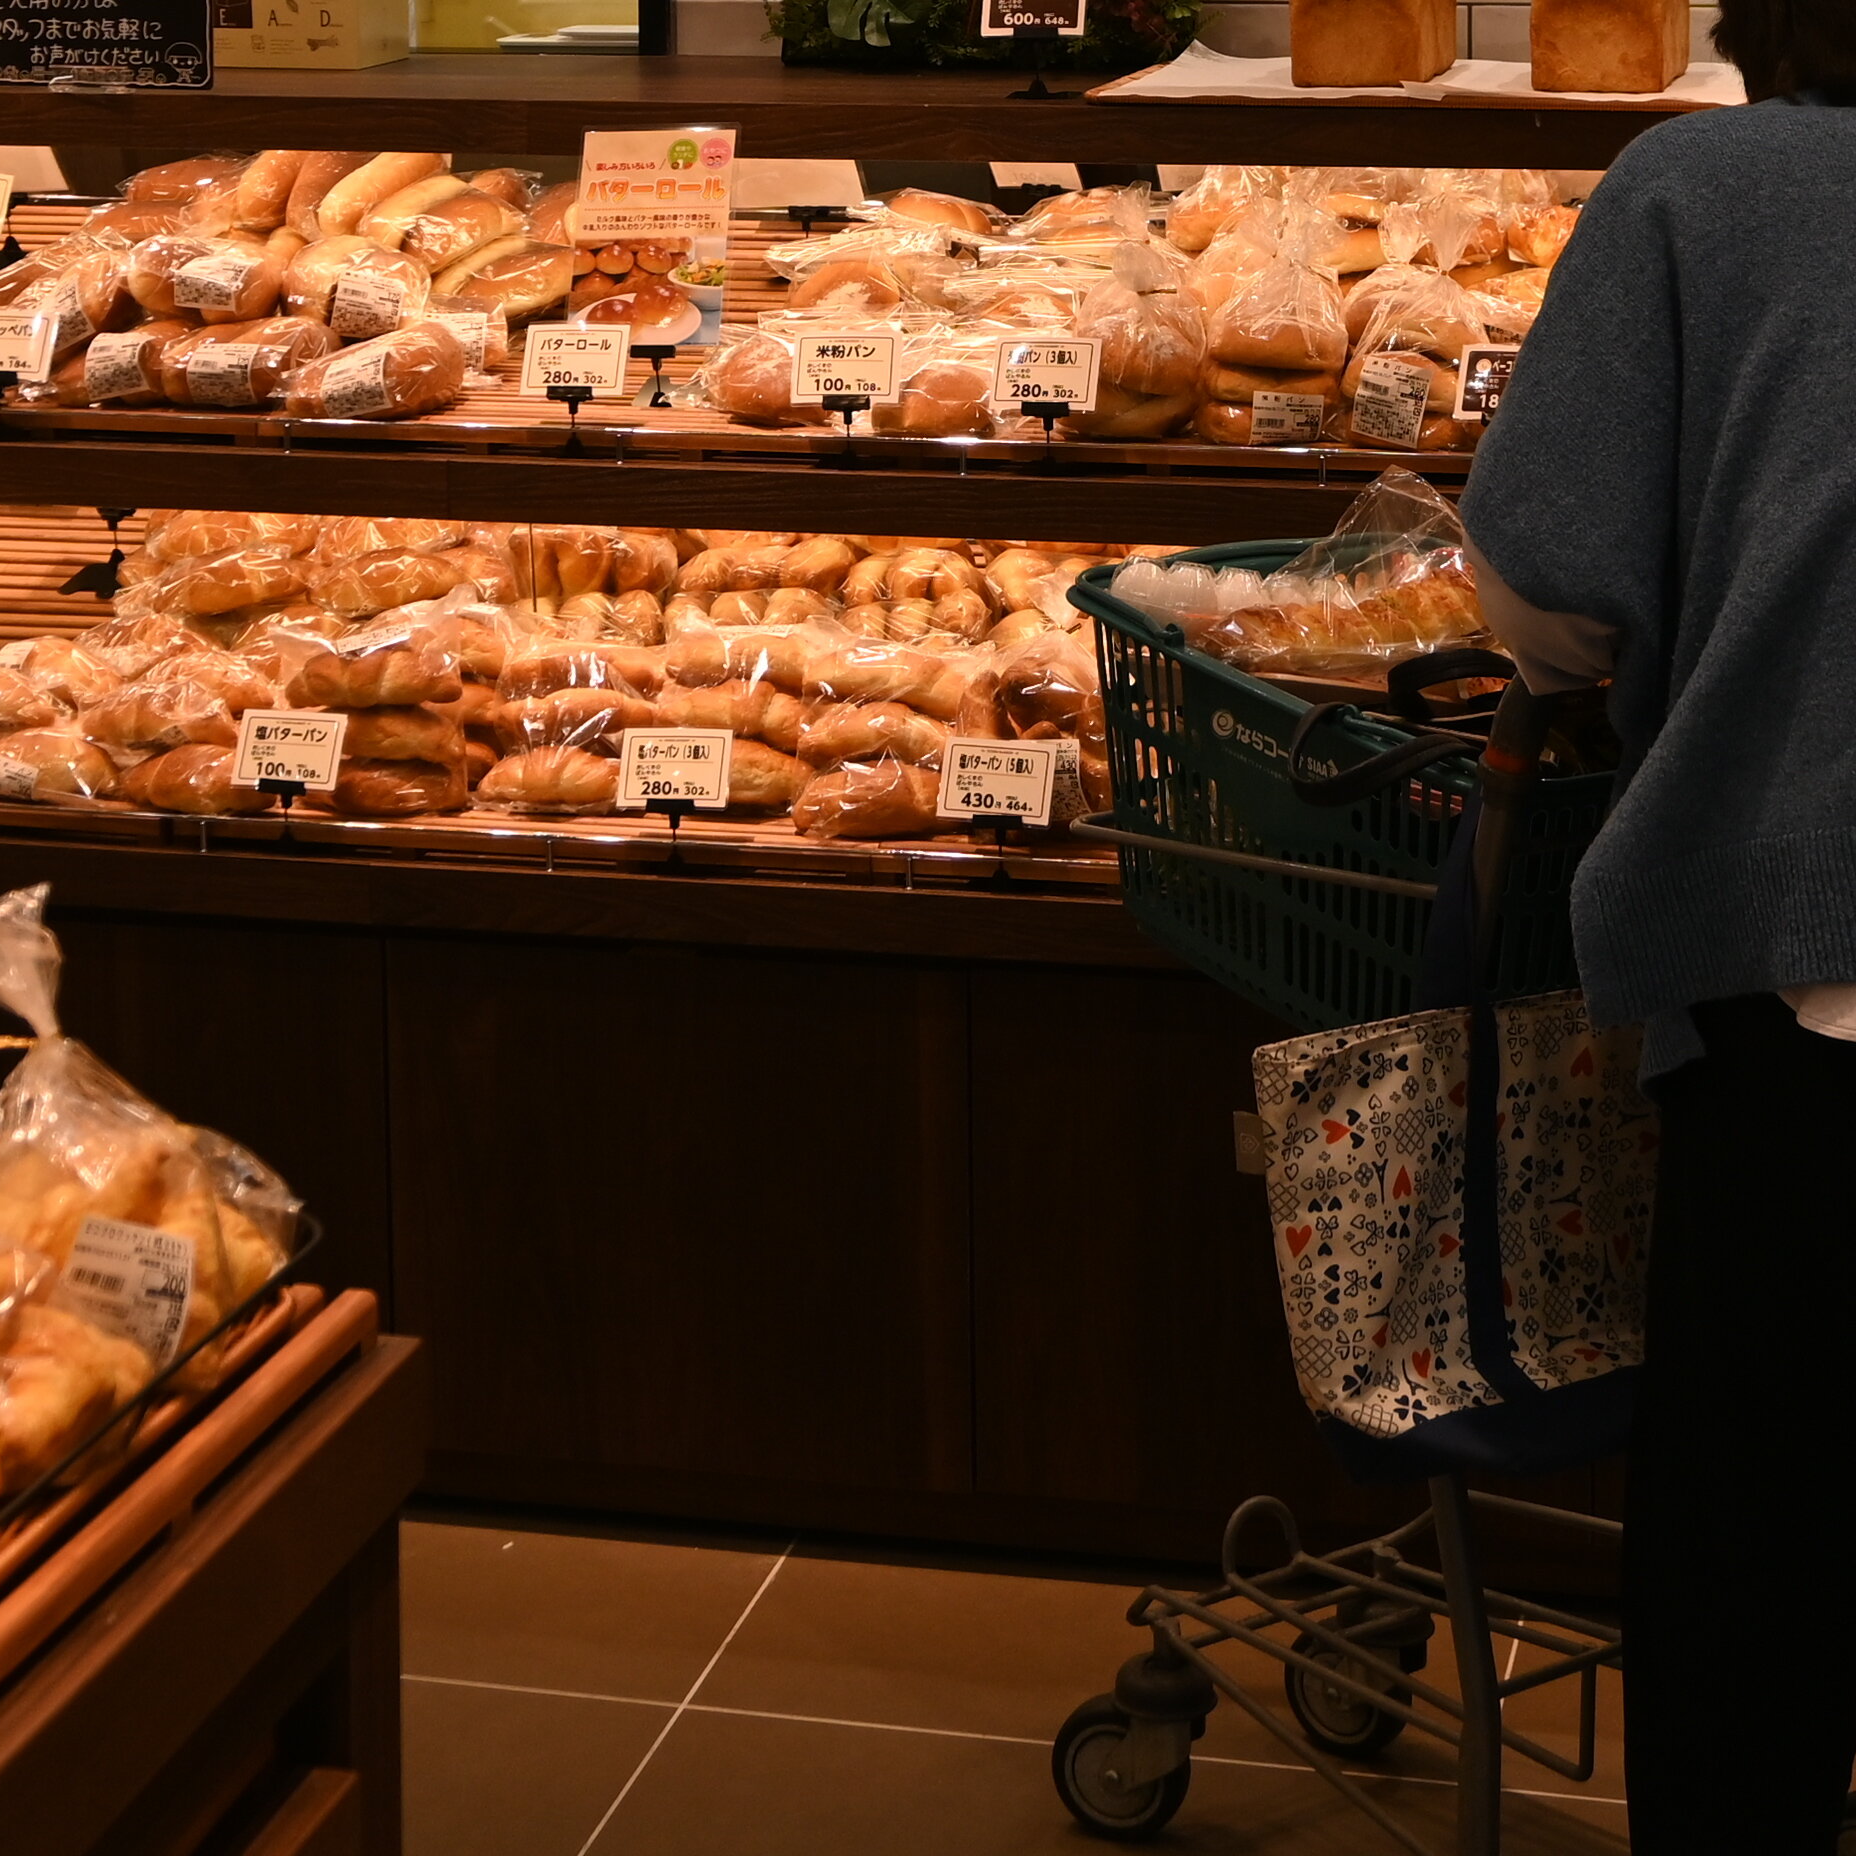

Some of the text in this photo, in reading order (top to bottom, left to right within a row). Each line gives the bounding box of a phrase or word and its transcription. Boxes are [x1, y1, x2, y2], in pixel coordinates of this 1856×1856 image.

[30, 44, 160, 66] お声がけください
[594, 162, 656, 172] 楽しみ方いろいろ
[586, 176, 726, 202] バターロール
[540, 338, 612, 350] バターロール
[814, 344, 876, 360] 米粉パン
[1492, 358, 1514, 374] ベーコ
[542, 370, 580, 384] 280円
[814, 378, 852, 392] 100円
[1010, 384, 1048, 398] 280円
[1480, 394, 1500, 408] 18
[254, 726, 328, 744] 塩バターパン
[256, 762, 292, 776] 100円
[640, 780, 680, 796] 280円
